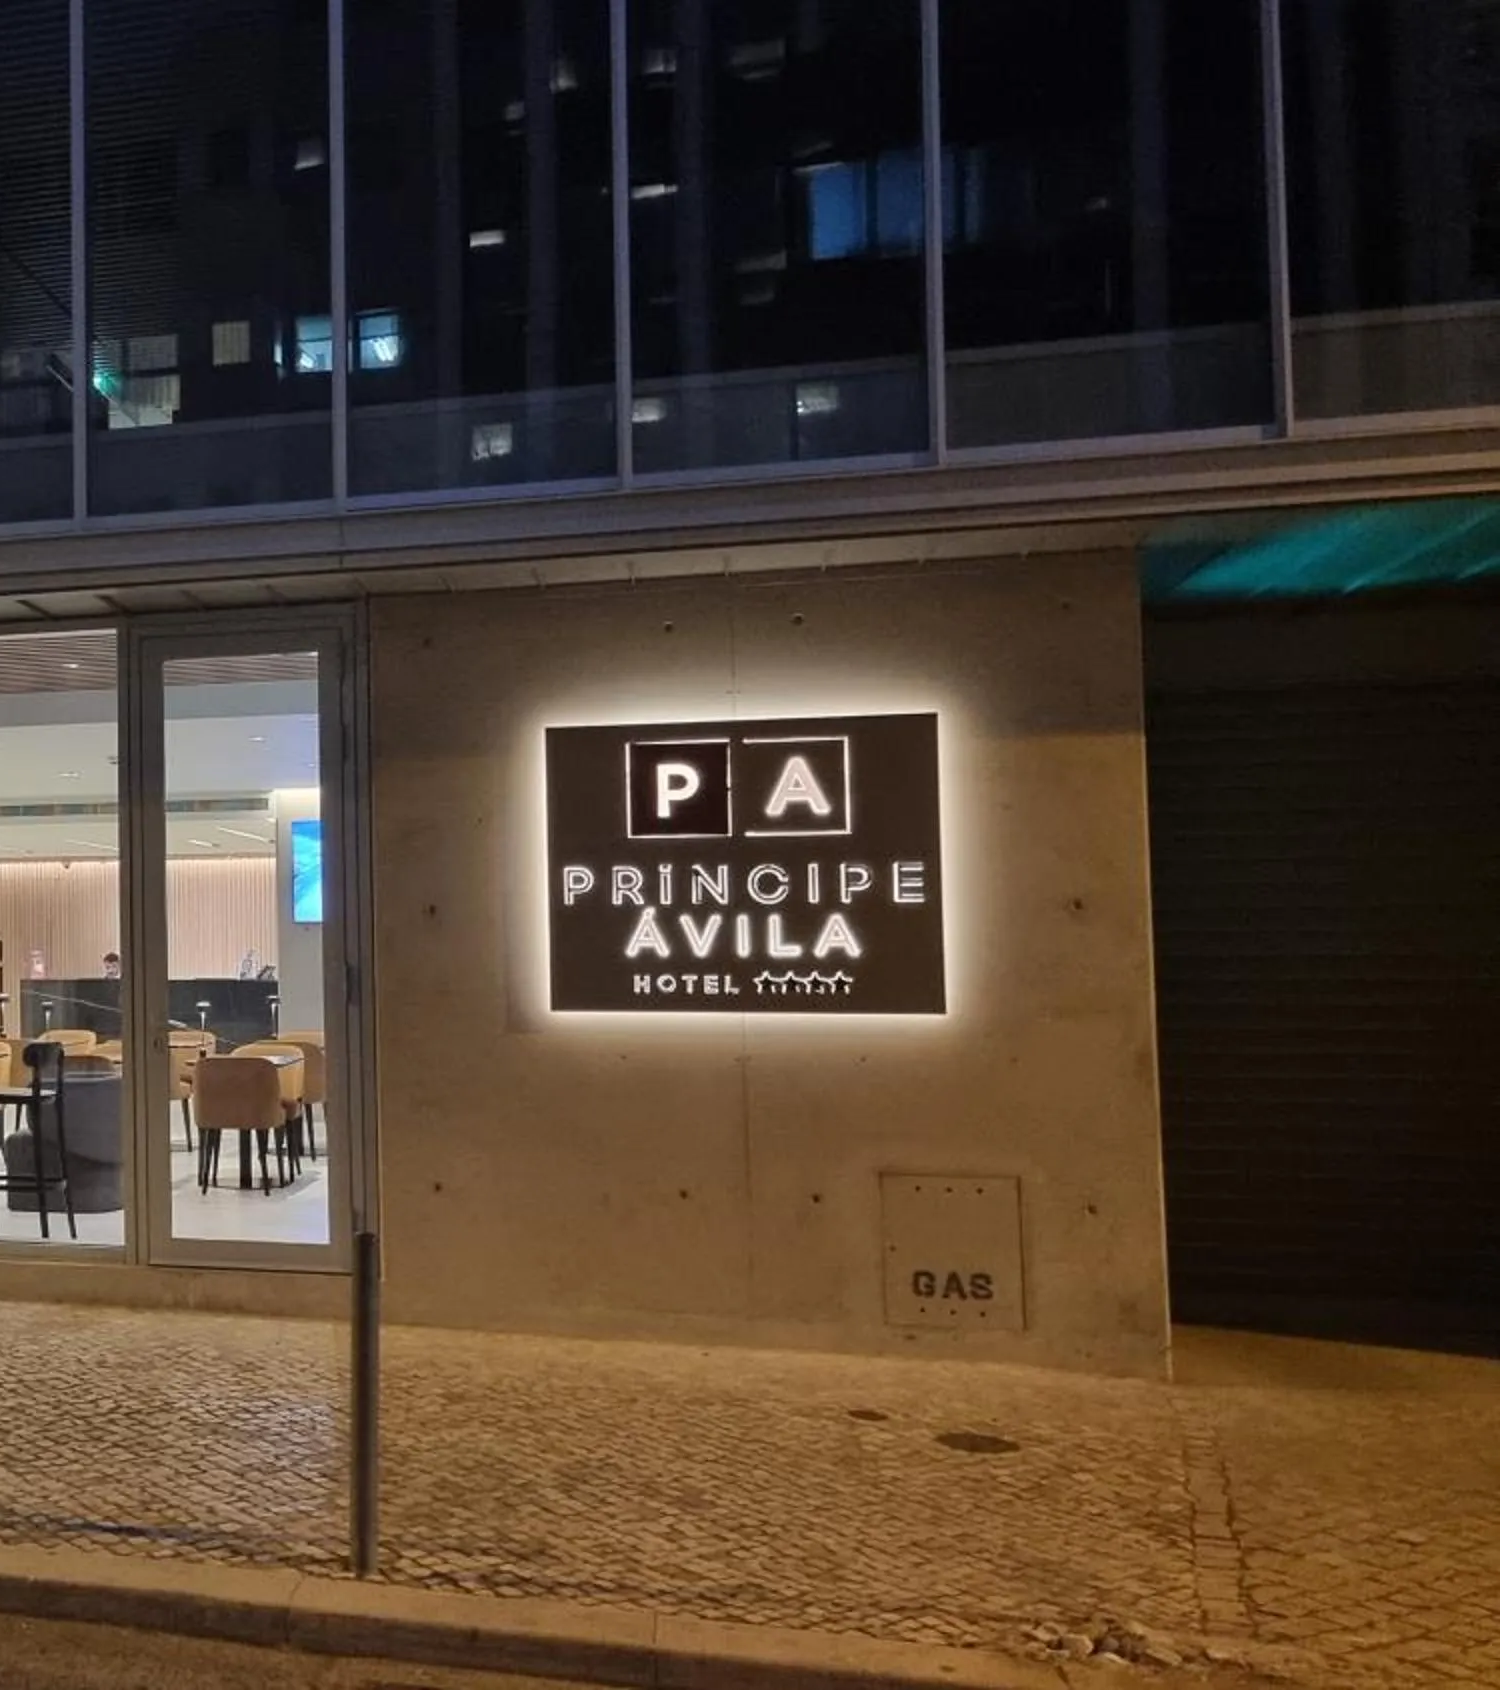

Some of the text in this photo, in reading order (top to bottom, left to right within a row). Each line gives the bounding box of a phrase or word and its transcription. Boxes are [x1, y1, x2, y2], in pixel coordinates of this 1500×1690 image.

[624, 907, 861, 958] ÁVILA
[633, 974, 739, 995] HOTEL
[911, 1270, 994, 1301] GAS
